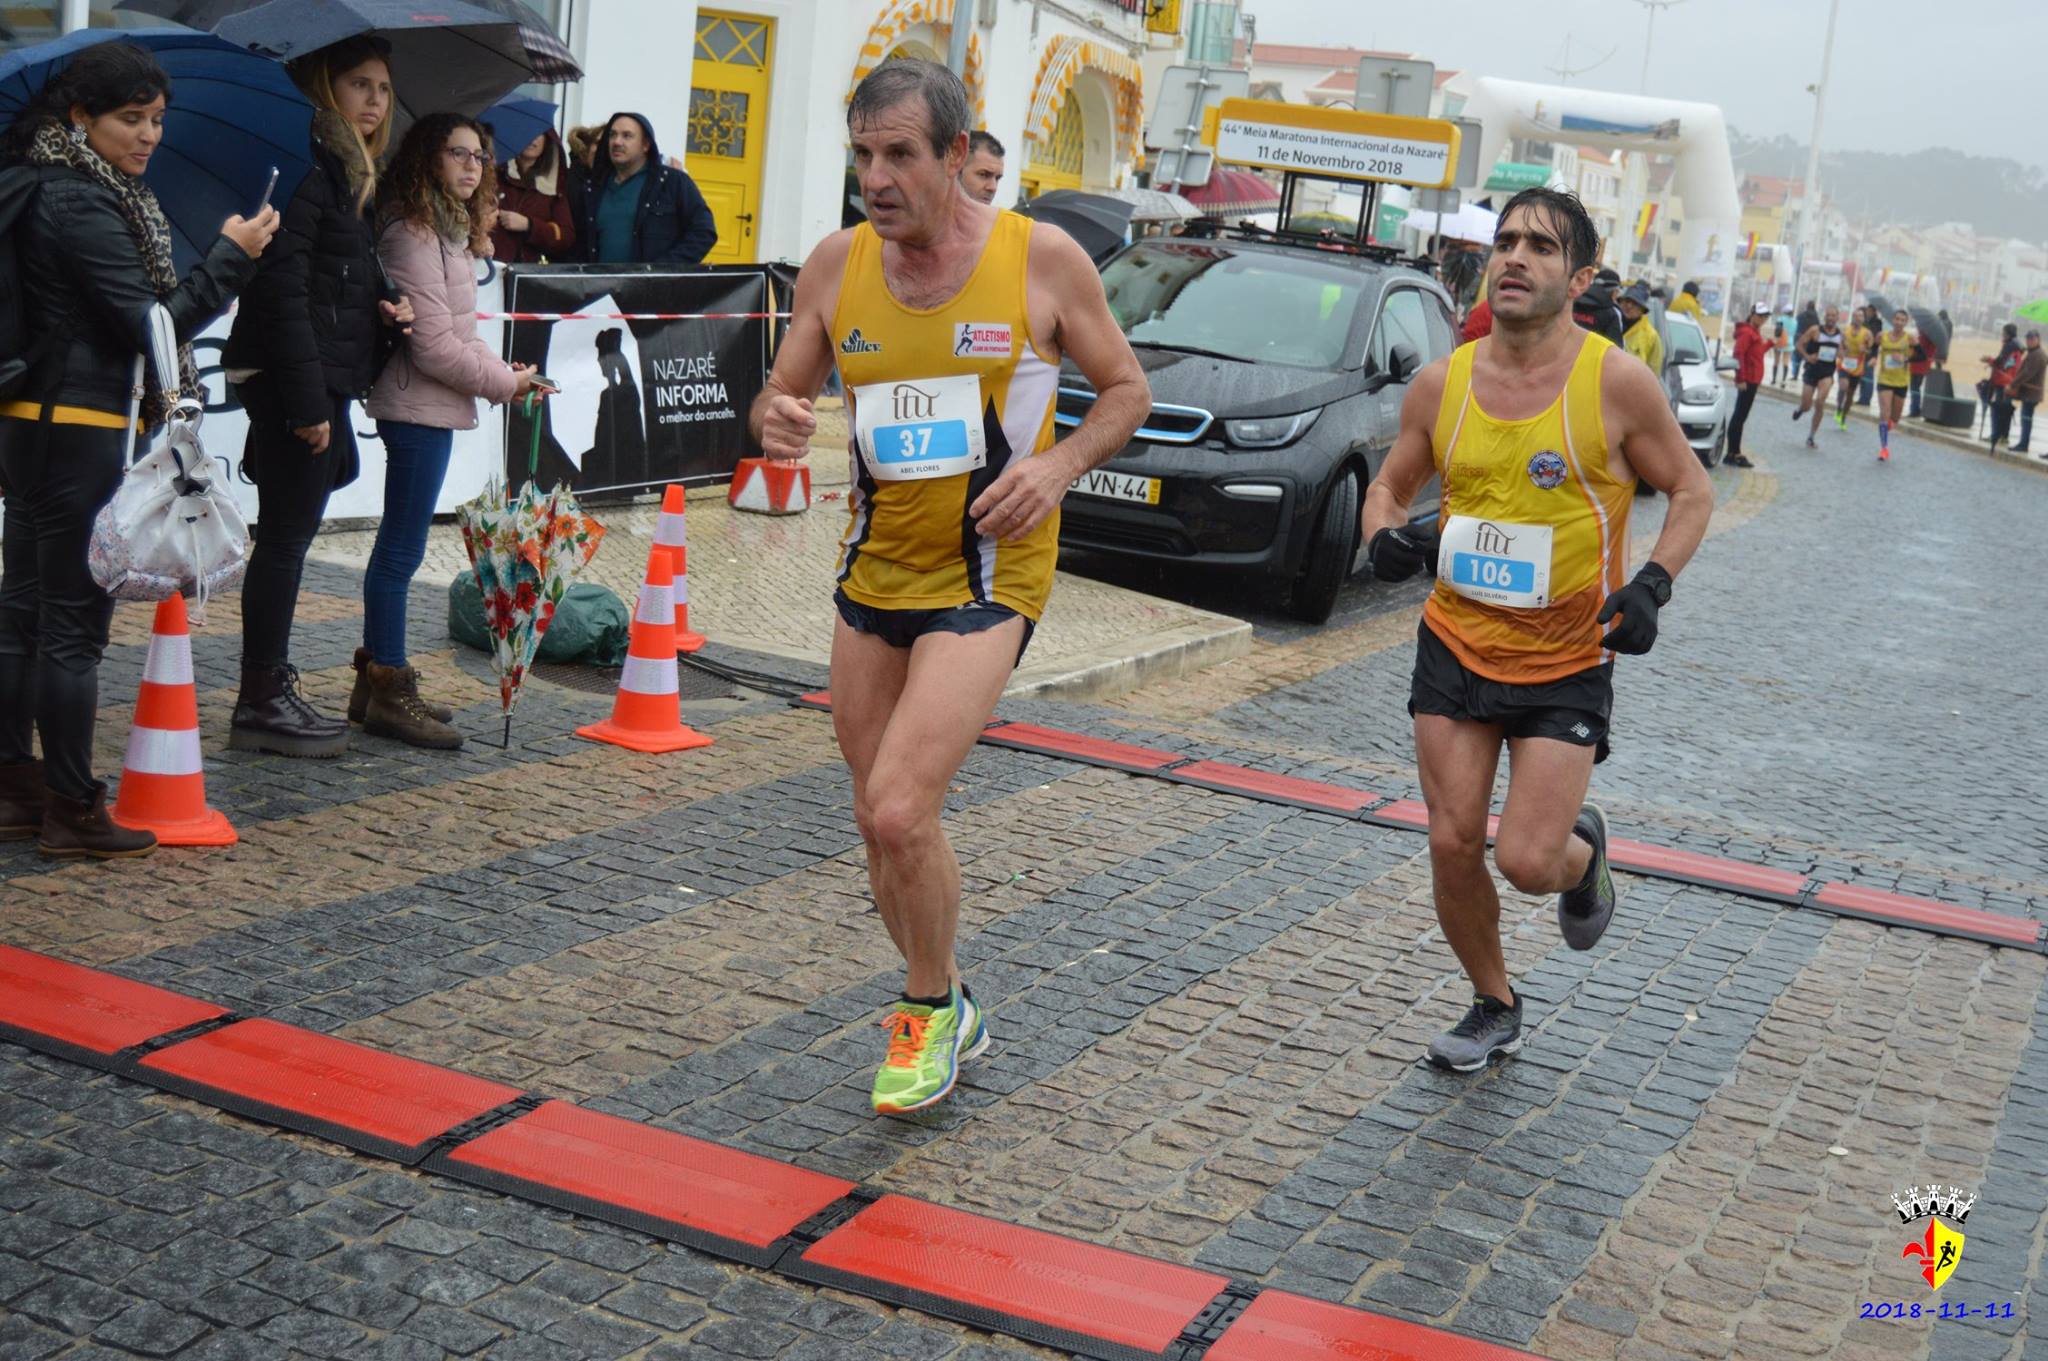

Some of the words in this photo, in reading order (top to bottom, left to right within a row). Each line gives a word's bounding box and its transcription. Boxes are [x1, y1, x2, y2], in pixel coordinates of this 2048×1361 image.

[1242, 126, 1267, 139] Meia
[1269, 129, 1319, 145] Maratona
[1320, 135, 1389, 154] Internacional
[1391, 144, 1404, 156] da
[1406, 146, 1444, 160] Nazaré
[1258, 146, 1269, 159] 11
[1272, 147, 1289, 162] de
[1292, 149, 1365, 172] Novembro
[1368, 159, 1403, 176] 2018
[972, 329, 1010, 344] ATLETISMO
[653, 351, 717, 380] NAZARÉ
[656, 383, 728, 408] INFORMA
[659, 415, 666, 424] o
[666, 410, 694, 423] melhor
[694, 409, 706, 421] do
[900, 427, 933, 458] 37
[900, 466, 915, 474] ABEL
[916, 464, 940, 473] FLORES
[1470, 559, 1512, 587] 106
